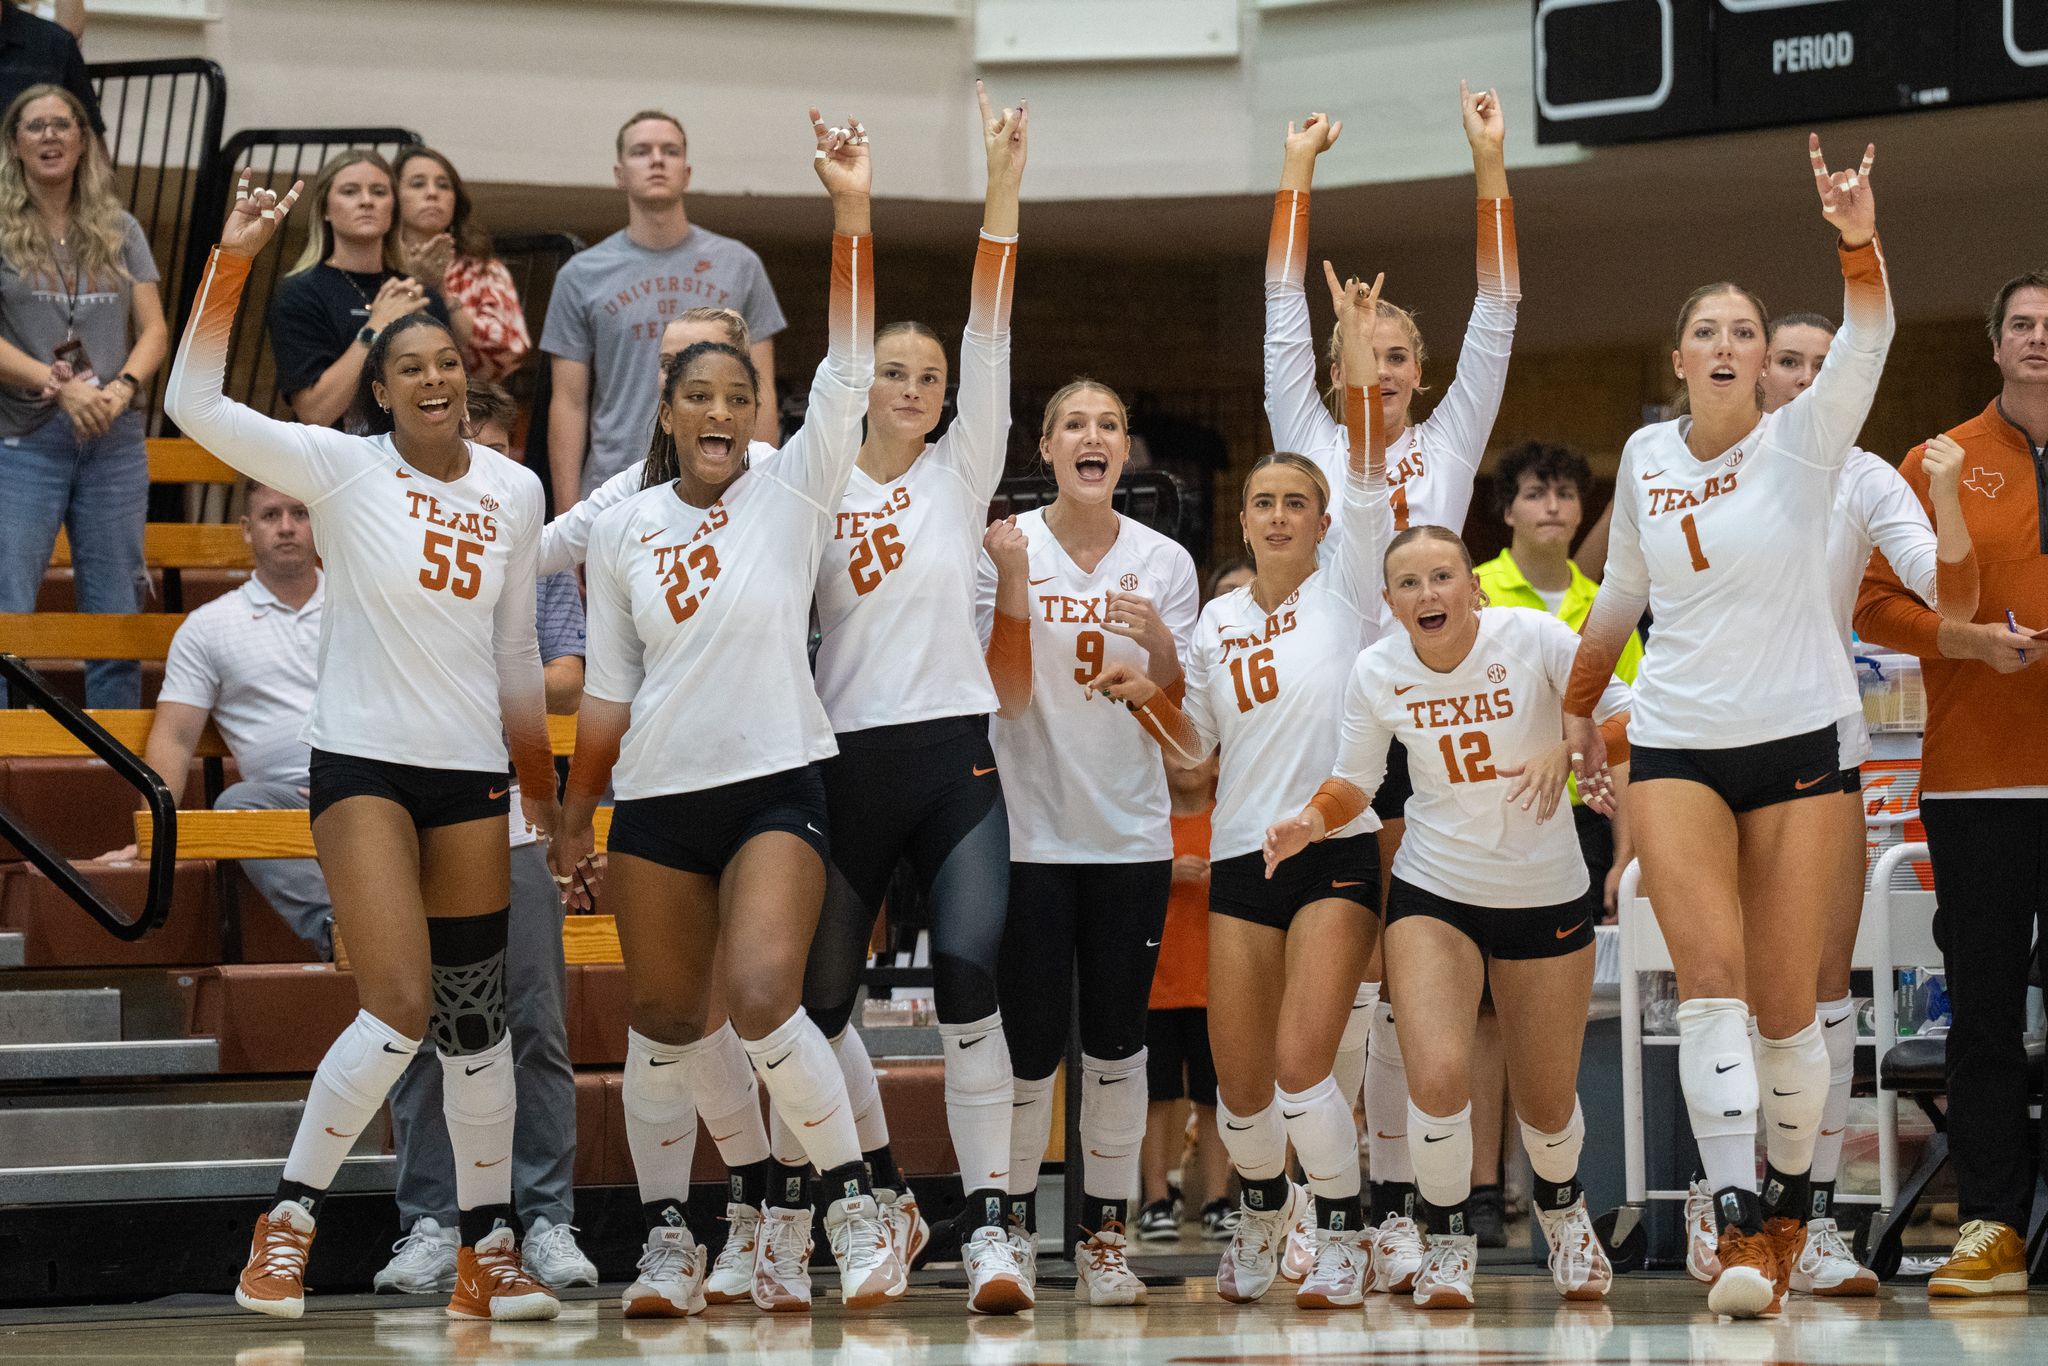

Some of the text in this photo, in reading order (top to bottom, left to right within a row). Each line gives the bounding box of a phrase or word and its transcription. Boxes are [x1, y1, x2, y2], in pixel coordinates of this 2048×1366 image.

[1773, 31, 1854, 75] PERIOD
[605, 276, 729, 316] UNIVERSITY
[658, 299, 677, 314] OF
[406, 490, 498, 542] TEXAS
[1649, 472, 1738, 516] TEXAS
[653, 499, 729, 576] TEAS
[1680, 513, 1710, 573] 1
[418, 529, 485, 601] 55
[848, 523, 906, 597] 26
[1120, 573, 1138, 591] SEC
[660, 544, 721, 625] 23
[1039, 595, 1129, 624] TEX
[1074, 631, 1104, 685] 9
[1487, 664, 1506, 683] SEC
[1229, 647, 1279, 714] 16
[1406, 687, 1514, 729] TEXAS
[1438, 730, 1497, 784] 12
[847, 1202, 861, 1210] NIKE
[664, 1232, 680, 1240] NIKE
